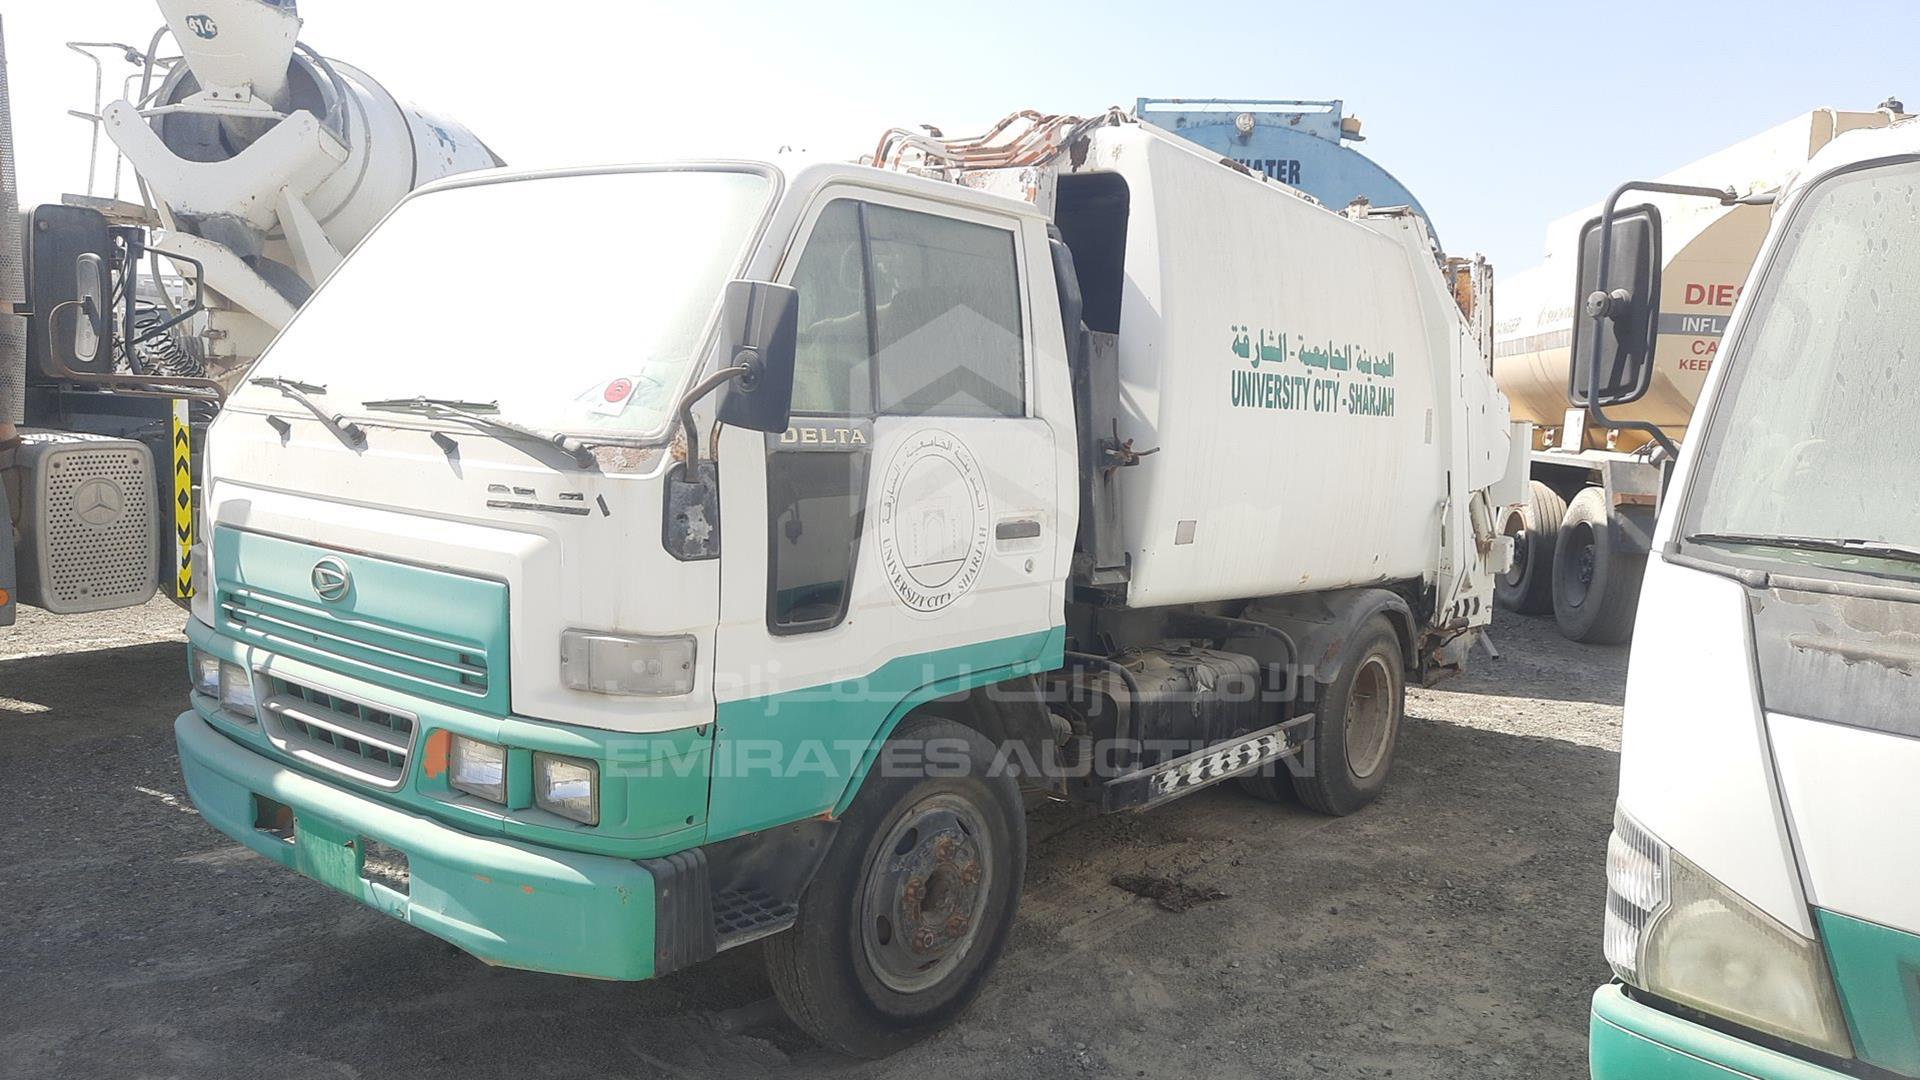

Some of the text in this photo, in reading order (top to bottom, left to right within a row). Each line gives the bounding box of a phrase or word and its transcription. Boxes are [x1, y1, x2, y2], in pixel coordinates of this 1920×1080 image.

[189, 17, 216, 34] 414
[1231, 325, 1287, 368] الشارقة
[1298, 334, 1351, 378] الجامعية
[1356, 345, 1394, 382] المدينة
[1231, 369, 1311, 411] UNIVERSITY
[1313, 378, 1340, 413] CITY
[1348, 383, 1394, 417] SHARJAH
[780, 427, 867, 444] DELTA
[882, 527, 987, 608] UNIVERSITY CITY SHARJAH
